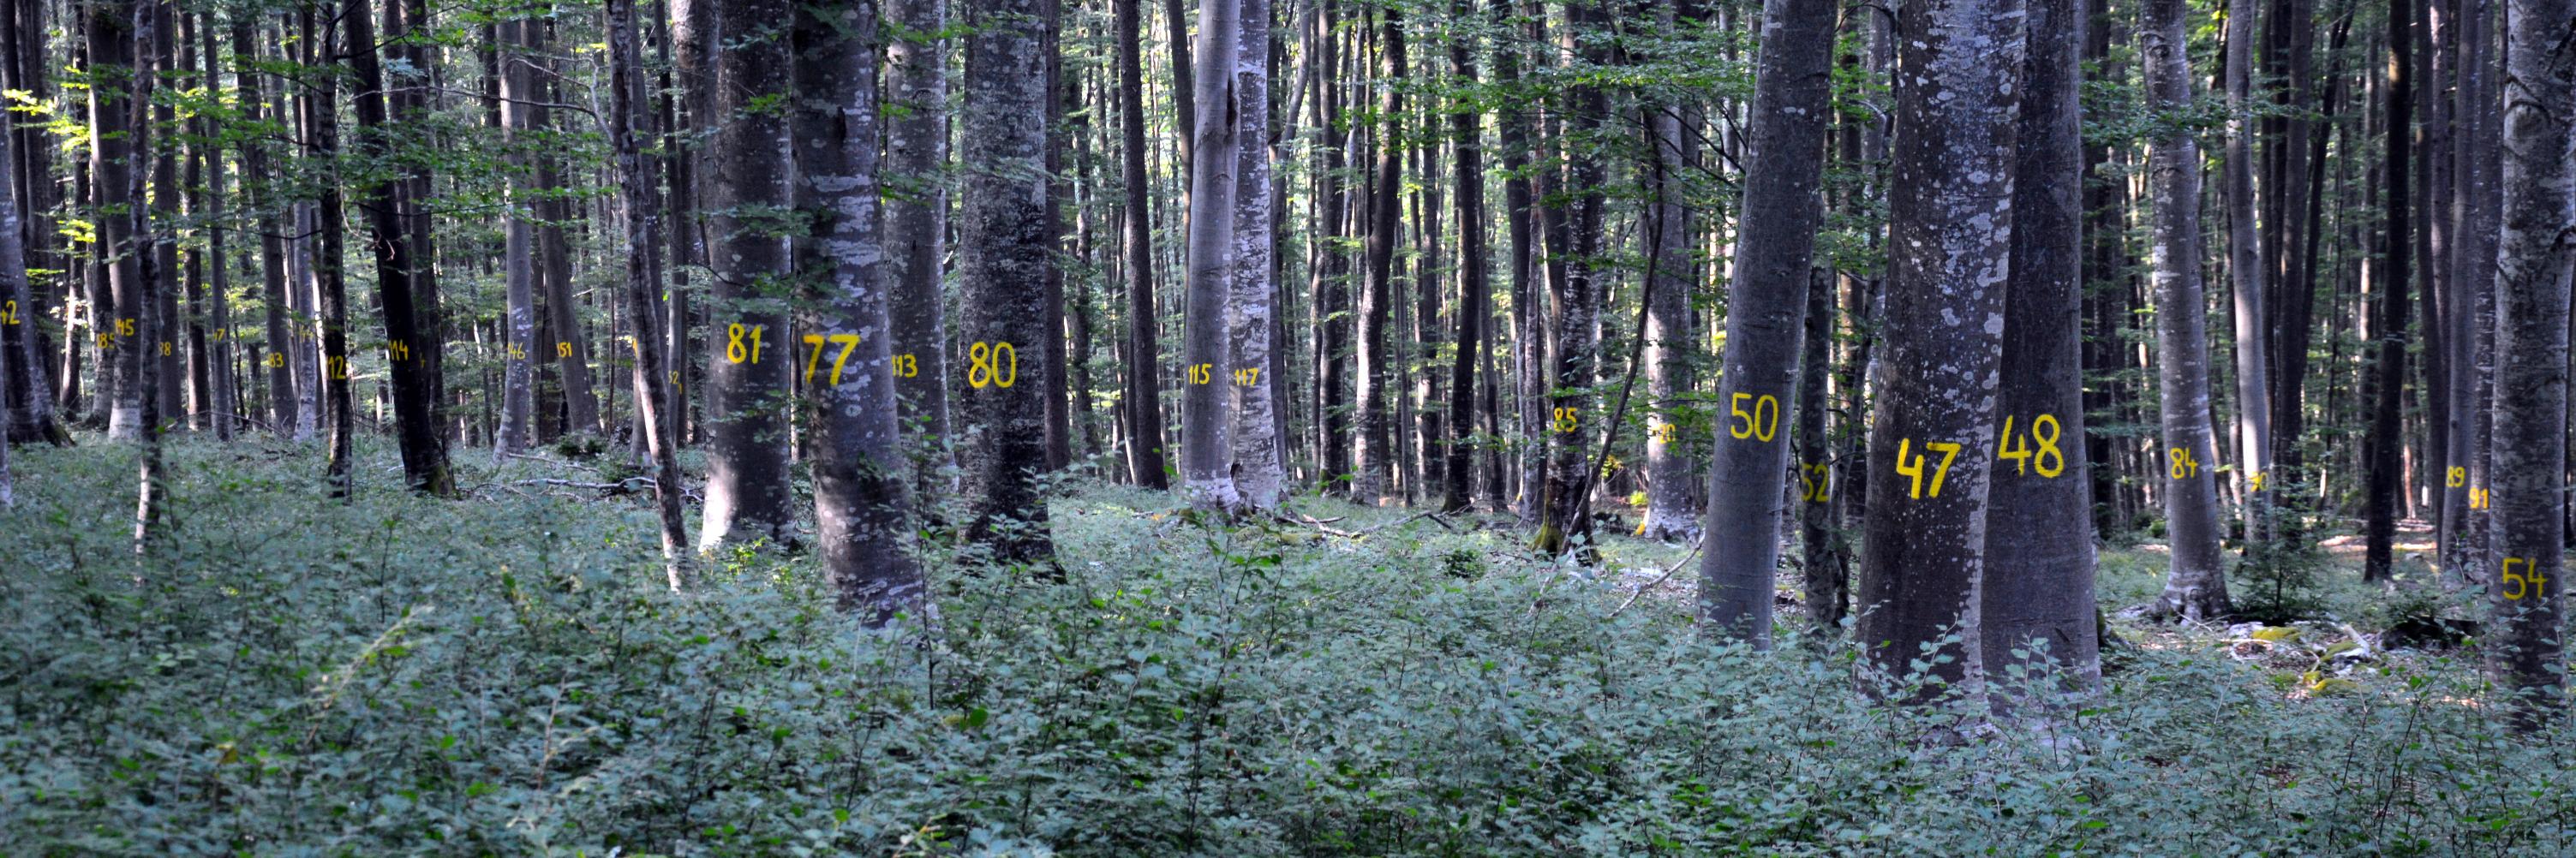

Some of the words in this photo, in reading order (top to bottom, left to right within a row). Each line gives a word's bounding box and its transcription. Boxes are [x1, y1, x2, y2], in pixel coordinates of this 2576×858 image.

[388, 339, 409, 361] 114
[726, 323, 762, 365] 81
[803, 334, 861, 386] 77
[892, 353, 919, 378] 113
[968, 341, 1017, 389] 80
[1188, 363, 1213, 384] 115
[1234, 367, 1259, 388] 117
[1553, 407, 1578, 432] 85
[1730, 391, 1779, 443] 50
[1997, 414, 2065, 479] 48
[2169, 446, 2198, 480] 84
[1801, 463, 1829, 503] 52
[1895, 438, 1962, 500] 47
[2446, 465, 2465, 488] 89
[2468, 486, 2489, 509] 91
[2501, 557, 2547, 600] 54
